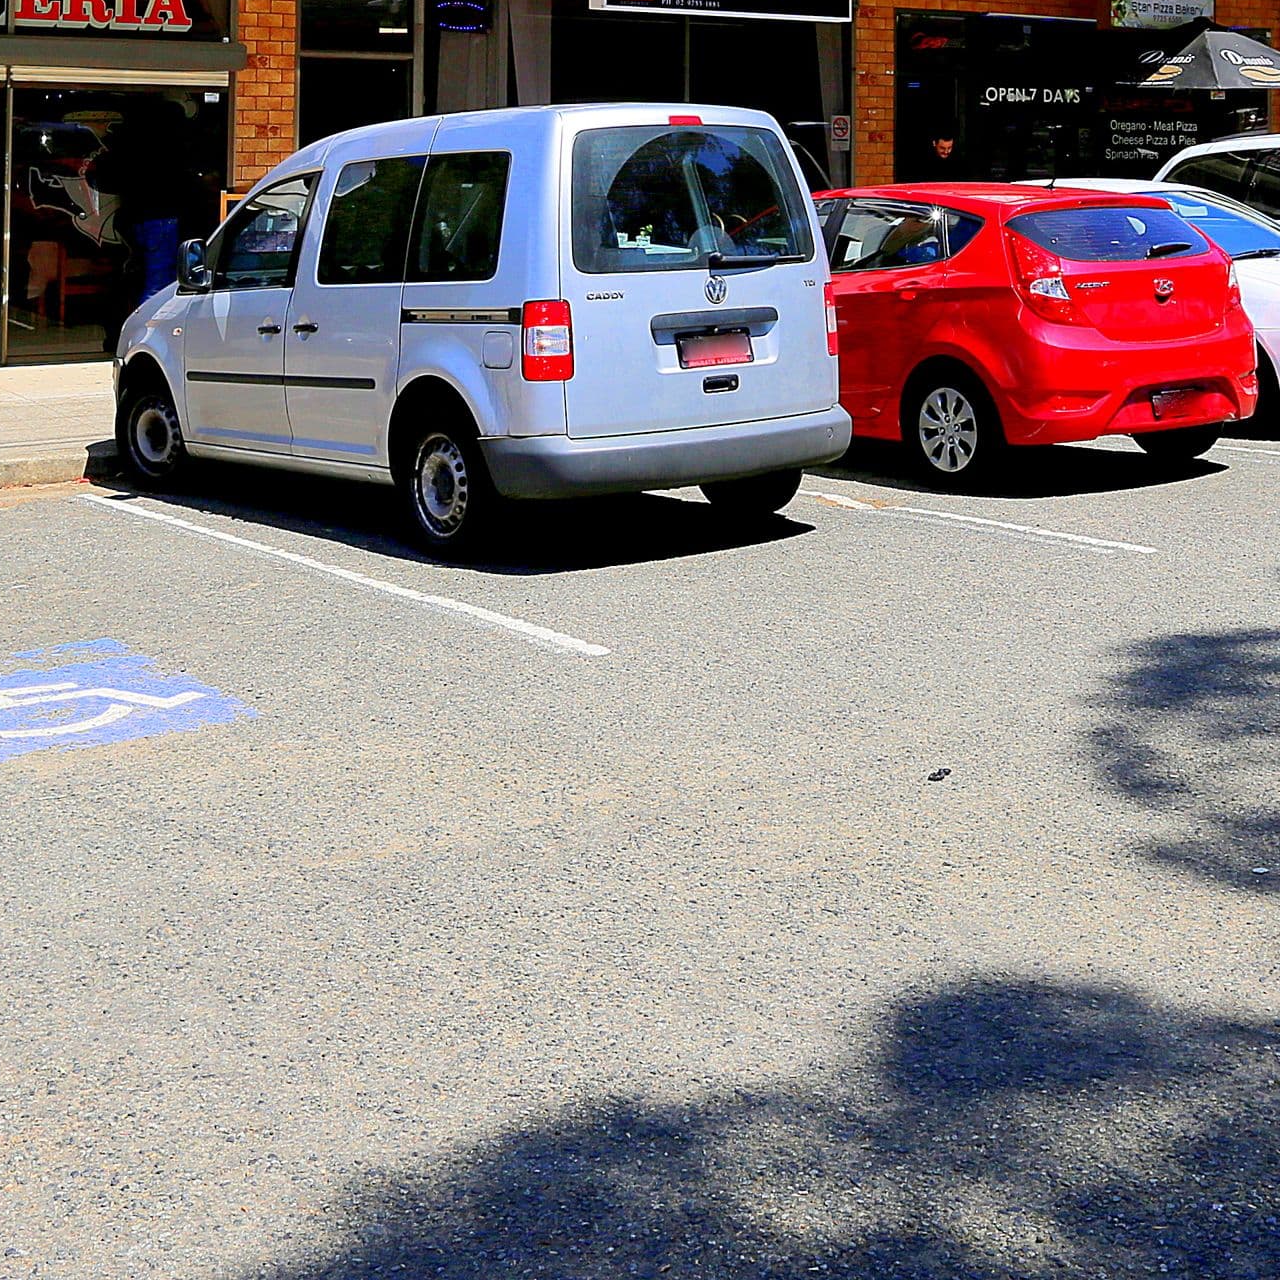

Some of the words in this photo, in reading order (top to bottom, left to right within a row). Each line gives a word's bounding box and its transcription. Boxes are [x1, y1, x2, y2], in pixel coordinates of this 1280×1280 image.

[1131, 1, 1152, 12] Star
[1153, 2, 1174, 14] Pizza
[1175, 4, 1205, 16] Bakery
[985, 87, 1026, 102] OPEN
[1028, 88, 1037, 100] 7
[1043, 89, 1081, 103] DAYS
[1110, 120, 1147, 133] Oregano
[1153, 121, 1175, 131] Meat
[1176, 121, 1198, 131] Pizza
[1111, 134, 1144, 145] Cheese
[1146, 135, 1168, 145] Pizza
[1170, 135, 1177, 146] &
[1178, 135, 1197, 146] Pies
[1105, 148, 1139, 160] Spinach
[586, 292, 626, 301] CADDY
